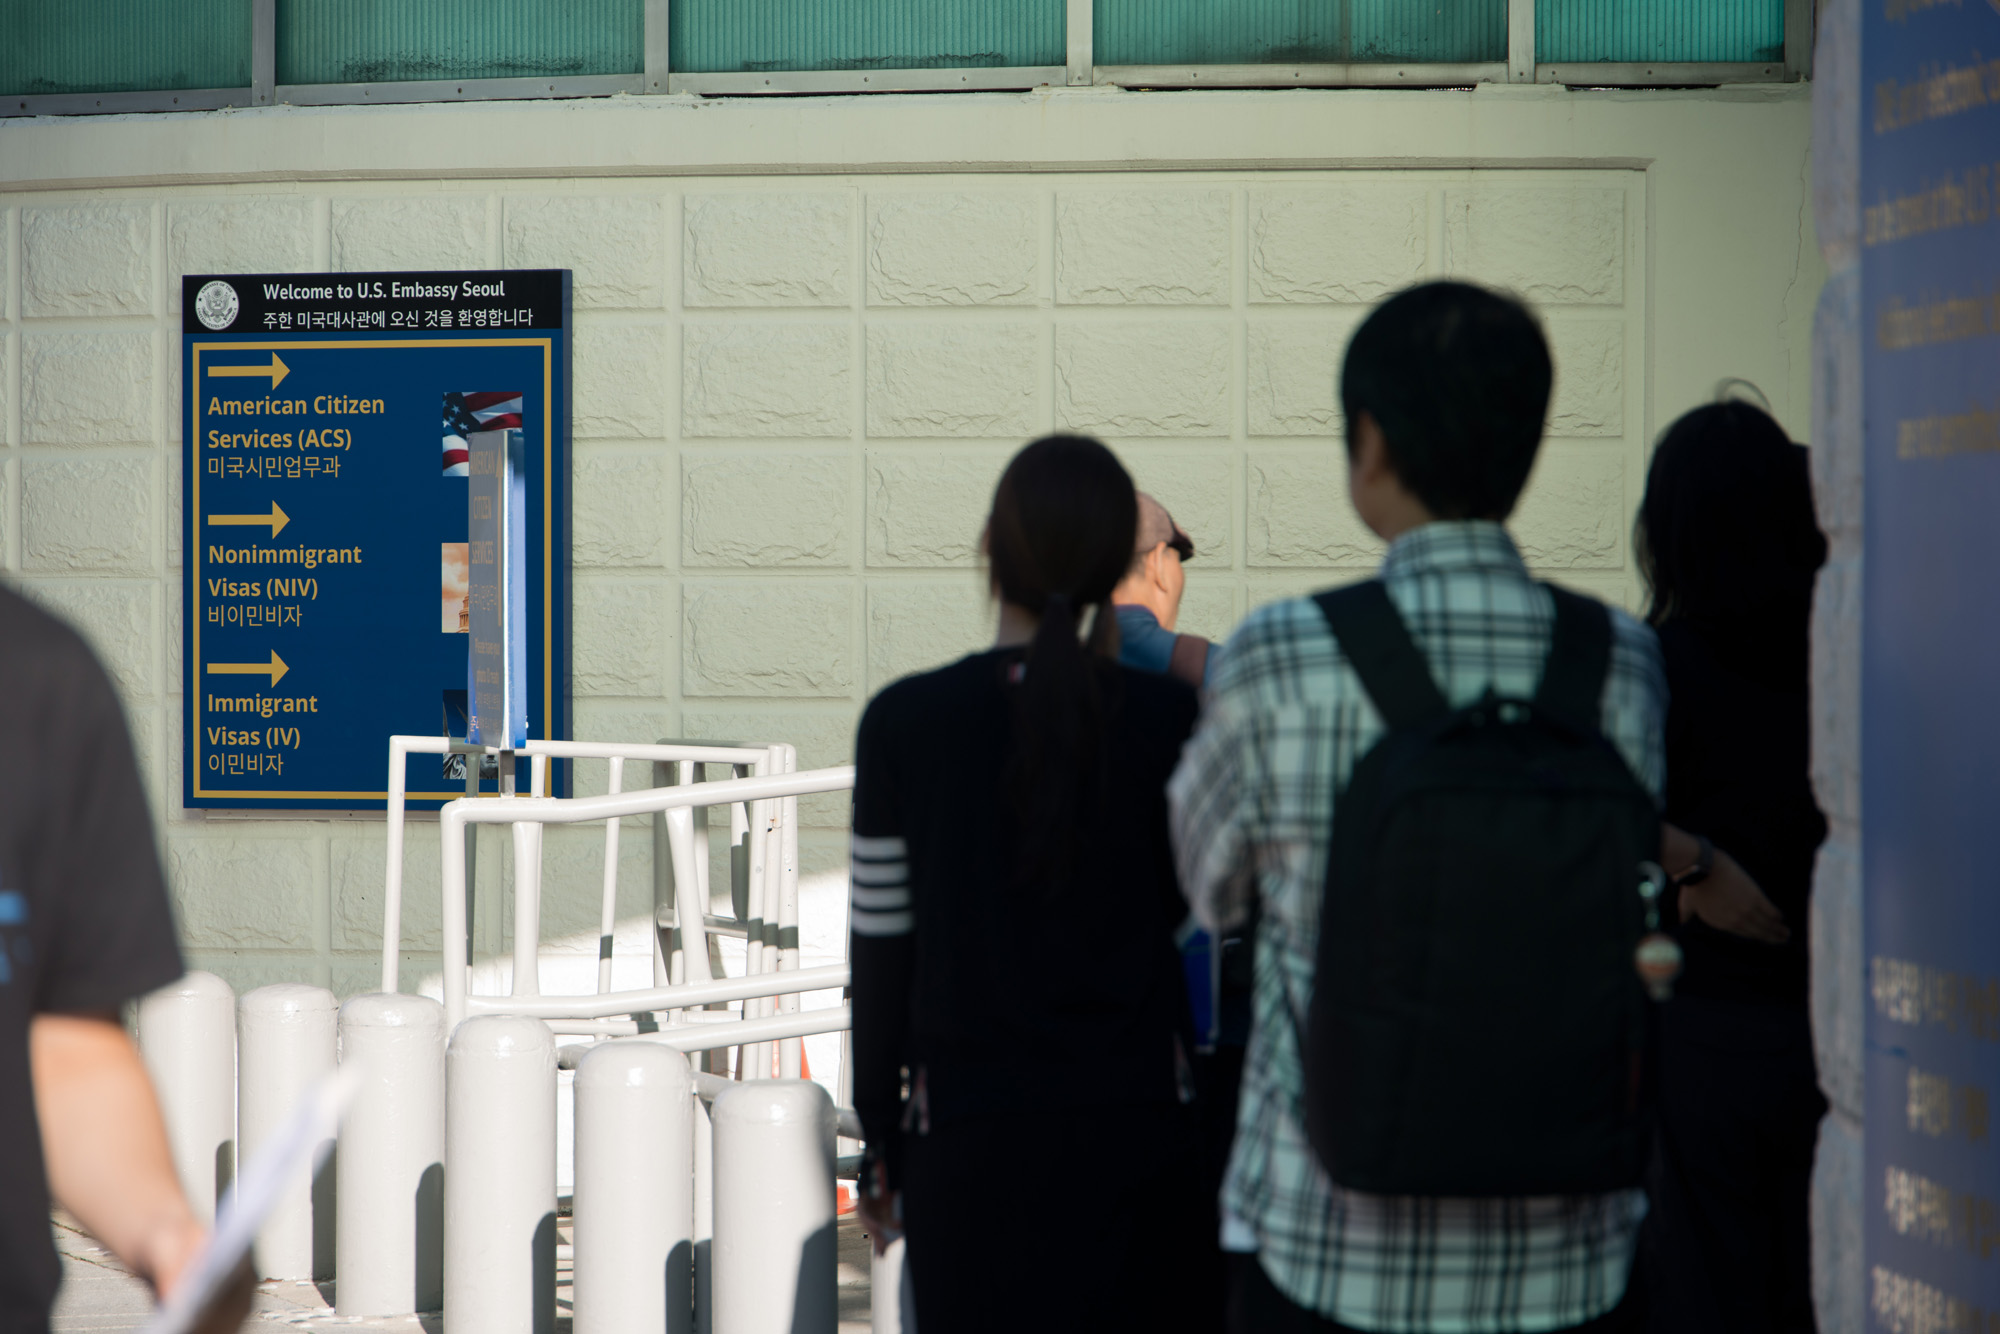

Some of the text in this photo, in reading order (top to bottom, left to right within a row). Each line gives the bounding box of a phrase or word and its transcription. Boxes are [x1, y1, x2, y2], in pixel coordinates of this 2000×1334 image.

[264, 281, 506, 301] Welcome to U.S. Embassy Seoul
[263, 308, 534, 330] 주한 미국대사관에 오신 것을 환영합니다
[208, 394, 385, 416] American Citizen
[208, 428, 352, 452] Services (ACS)
[208, 455, 342, 479] 미국시민업무과
[208, 543, 363, 569] Nonimmigrant
[208, 577, 319, 601] Visas (NIV)
[208, 604, 303, 628] 비이민비자
[208, 692, 319, 718] Immigrant
[207, 726, 301, 750] Visas (IV)
[207, 752, 285, 776] 이민비자
